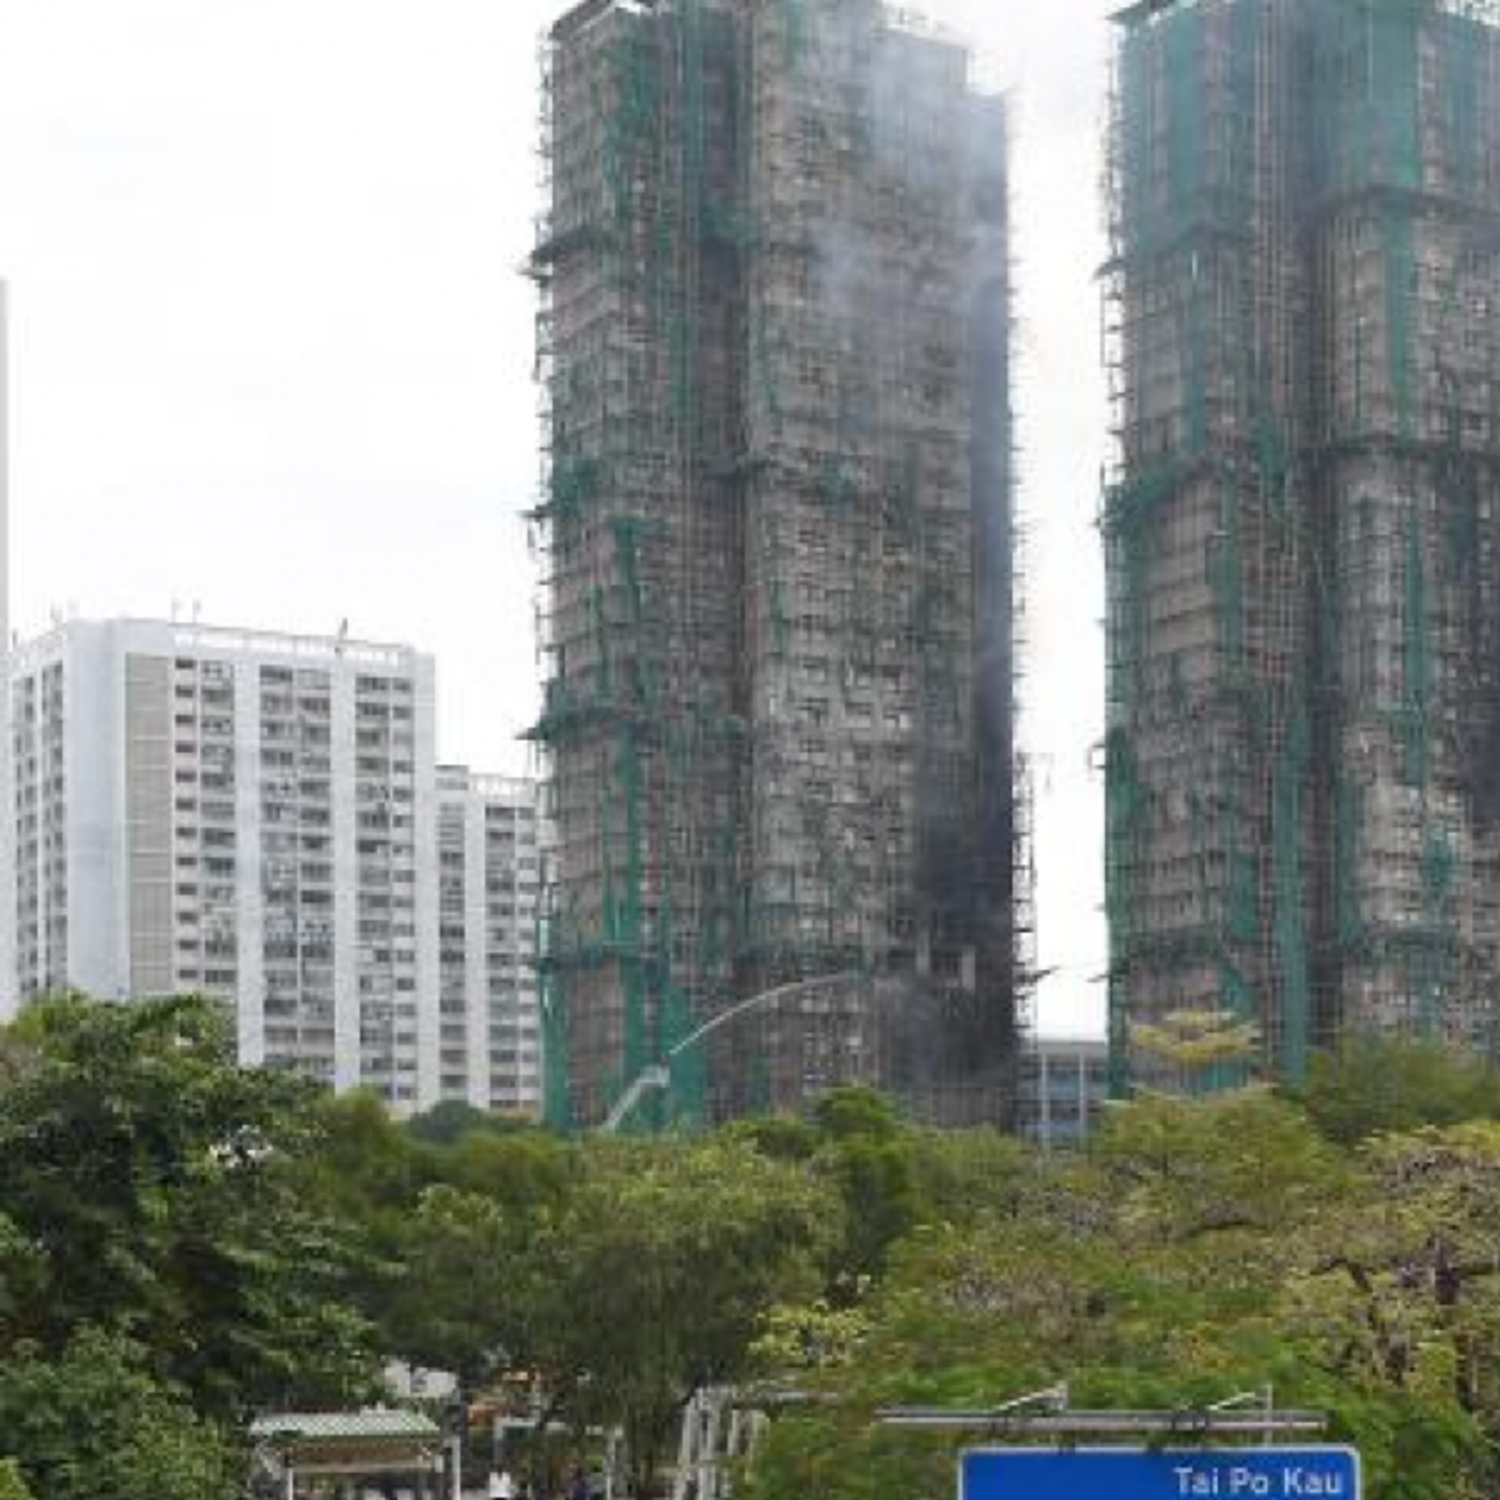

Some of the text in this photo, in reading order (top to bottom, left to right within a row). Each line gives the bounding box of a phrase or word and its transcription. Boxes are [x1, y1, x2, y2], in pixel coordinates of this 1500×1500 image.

[1173, 1466, 1342, 1494] Tai Po Kau
